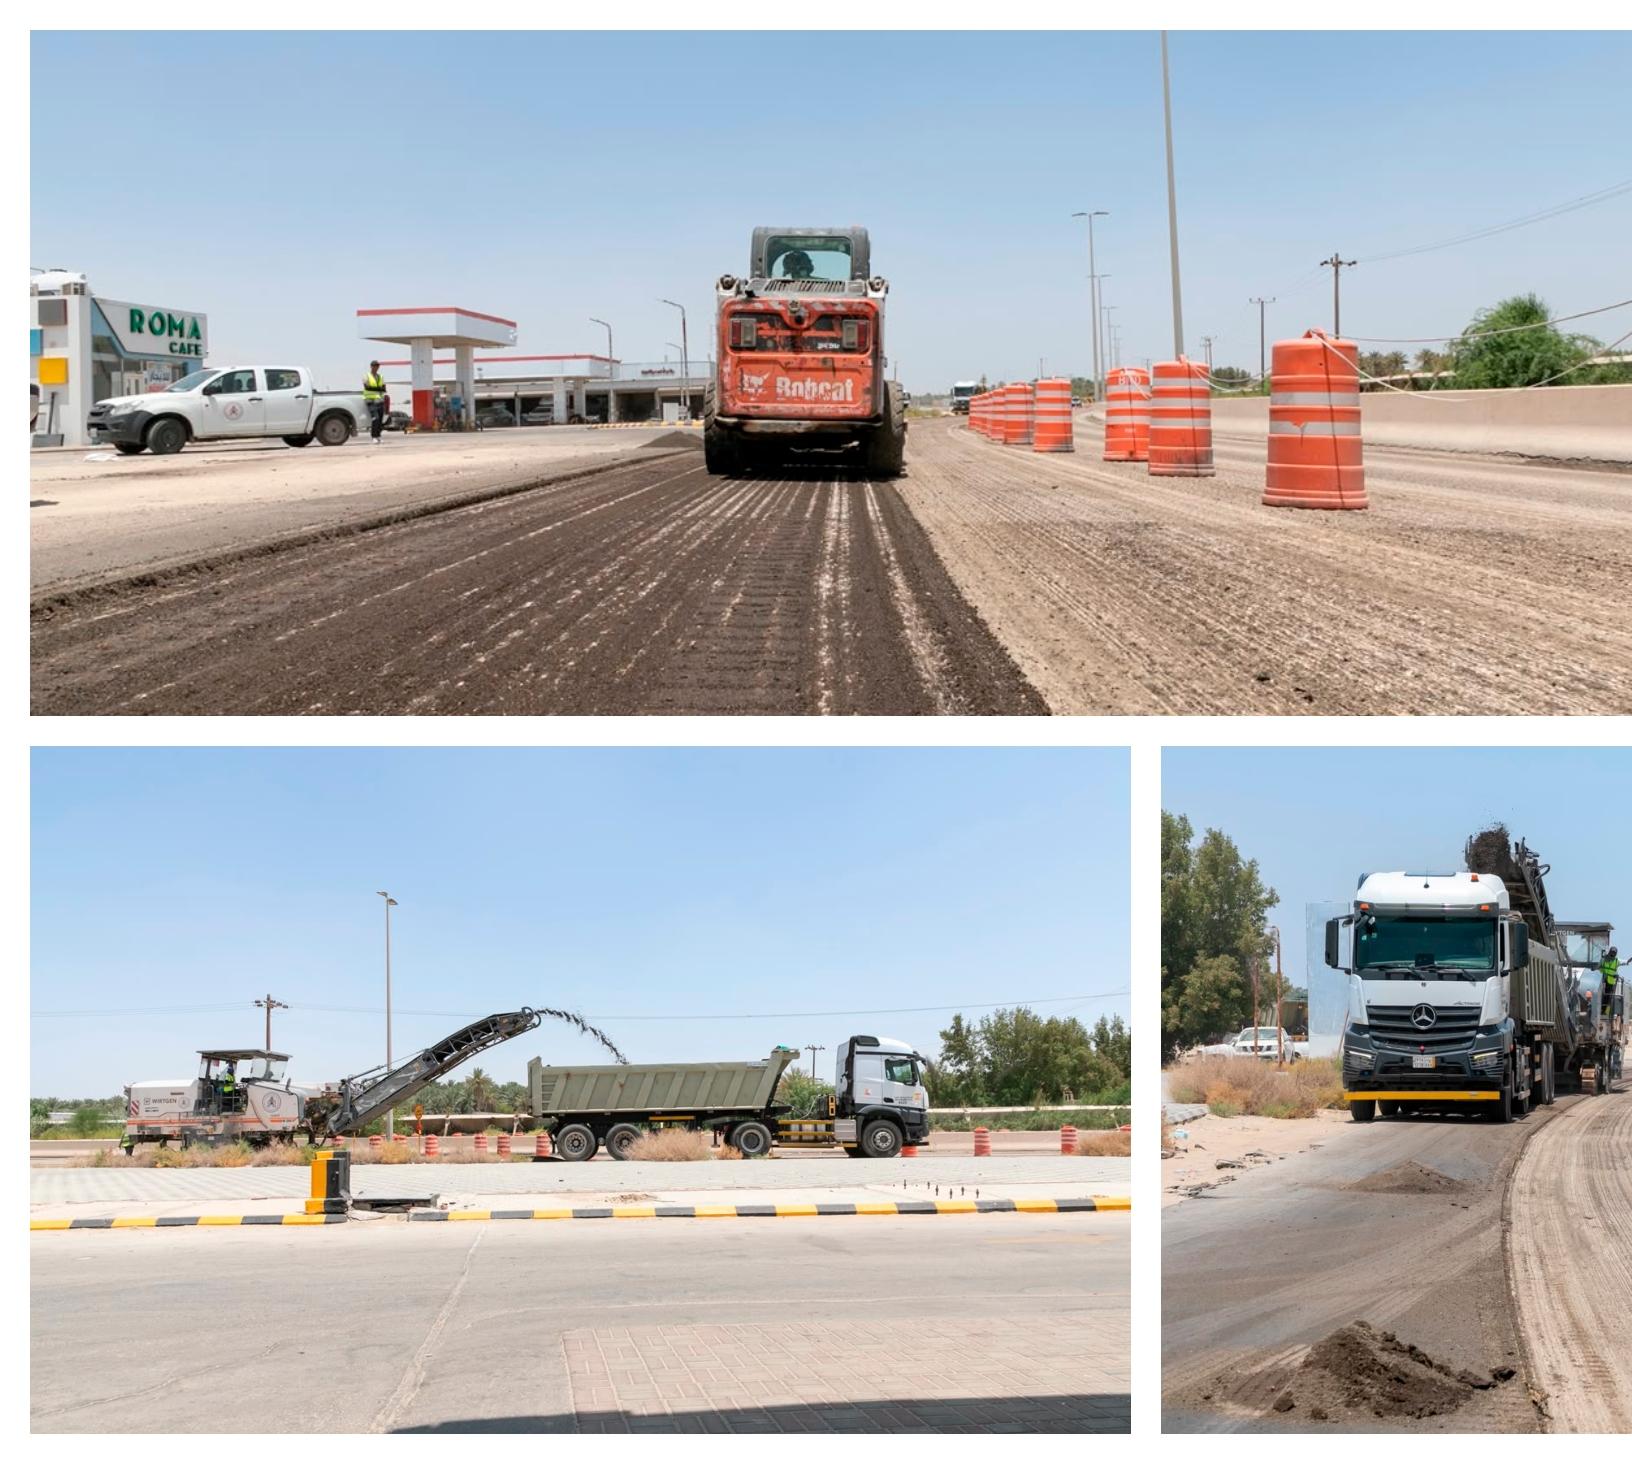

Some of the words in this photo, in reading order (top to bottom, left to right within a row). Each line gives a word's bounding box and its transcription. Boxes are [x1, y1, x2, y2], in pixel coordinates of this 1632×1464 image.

[129, 308, 202, 340] ROMA
[169, 341, 203, 356] CAFE
[776, 377, 853, 401] Bobcat
